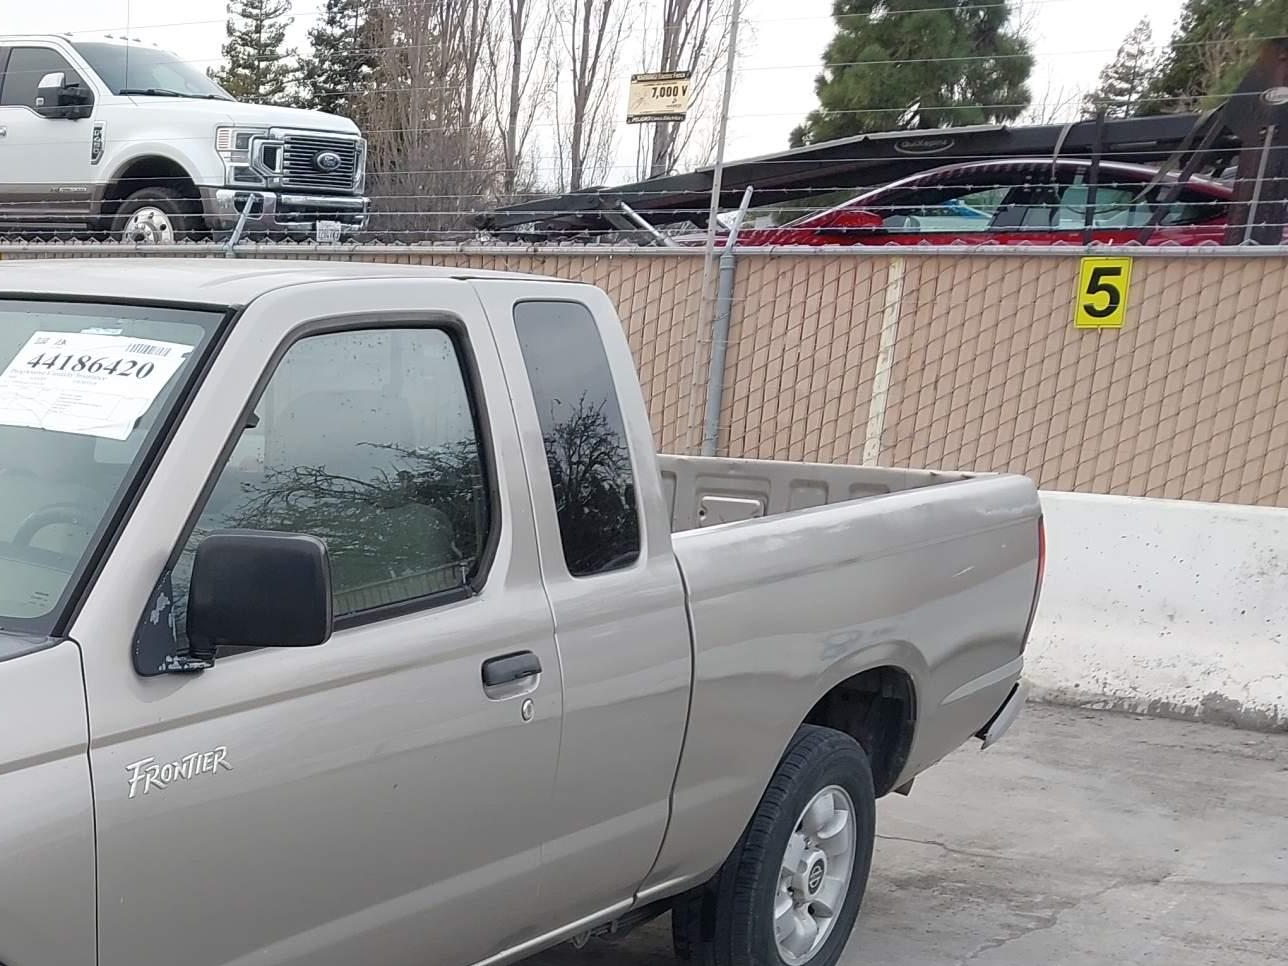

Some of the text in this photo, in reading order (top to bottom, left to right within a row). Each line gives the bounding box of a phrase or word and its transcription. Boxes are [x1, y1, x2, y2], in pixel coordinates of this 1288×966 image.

[651, 85, 689, 99] 7,000 V
[1083, 267, 1122, 318] 5
[26, 352, 155, 380] 44186420
[125, 746, 234, 799] FRONTIER
